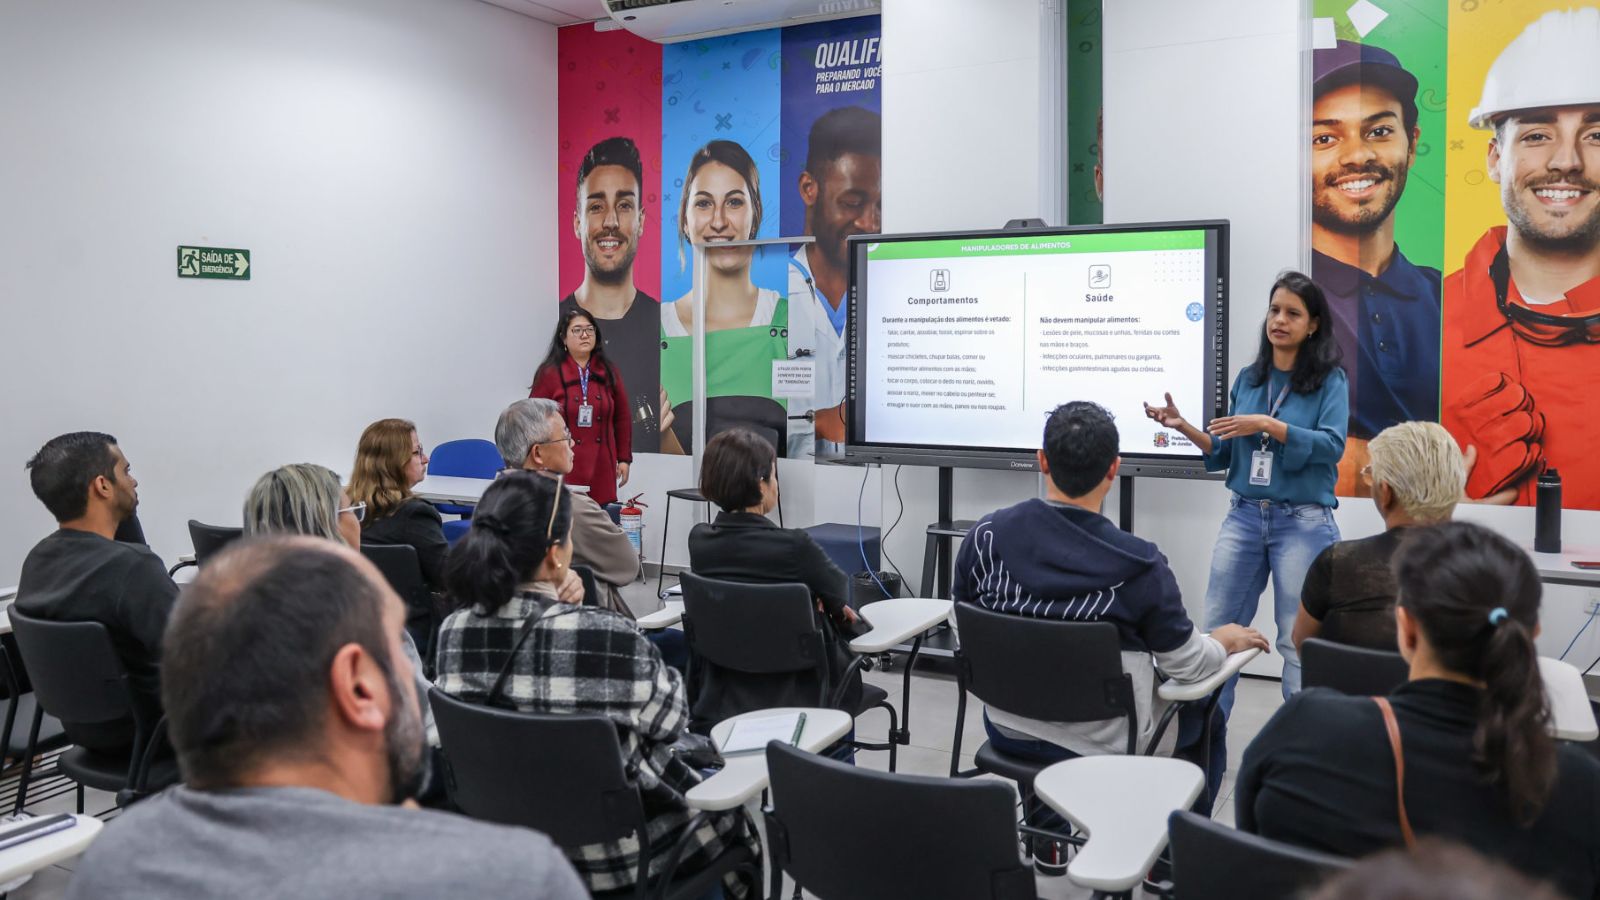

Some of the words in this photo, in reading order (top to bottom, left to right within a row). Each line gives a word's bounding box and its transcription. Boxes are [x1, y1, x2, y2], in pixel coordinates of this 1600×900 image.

[816, 69, 861, 83] PREPARANDO
[816, 84, 834, 94] PARA
[835, 83, 841, 92] O
[841, 79, 875, 92] MERCADO
[961, 244, 1019, 252] MANIPULADORES
[1031, 241, 1071, 250] ALIMENTOS
[201, 250, 222, 264] SAÍDA
[224, 253, 234, 264] DE
[201, 264, 234, 274] EMERGÊNCIA
[907, 297, 979, 306] Comportamentos
[1085, 293, 1114, 303] Saúde
[909, 316, 944, 324] manipulação
[1040, 316, 1052, 324] Não
[1074, 316, 1106, 325] manipular
[1107, 316, 1141, 324] alimentos:
[1095, 353, 1127, 361] pulmonares
[1111, 365, 1130, 373] agudas
